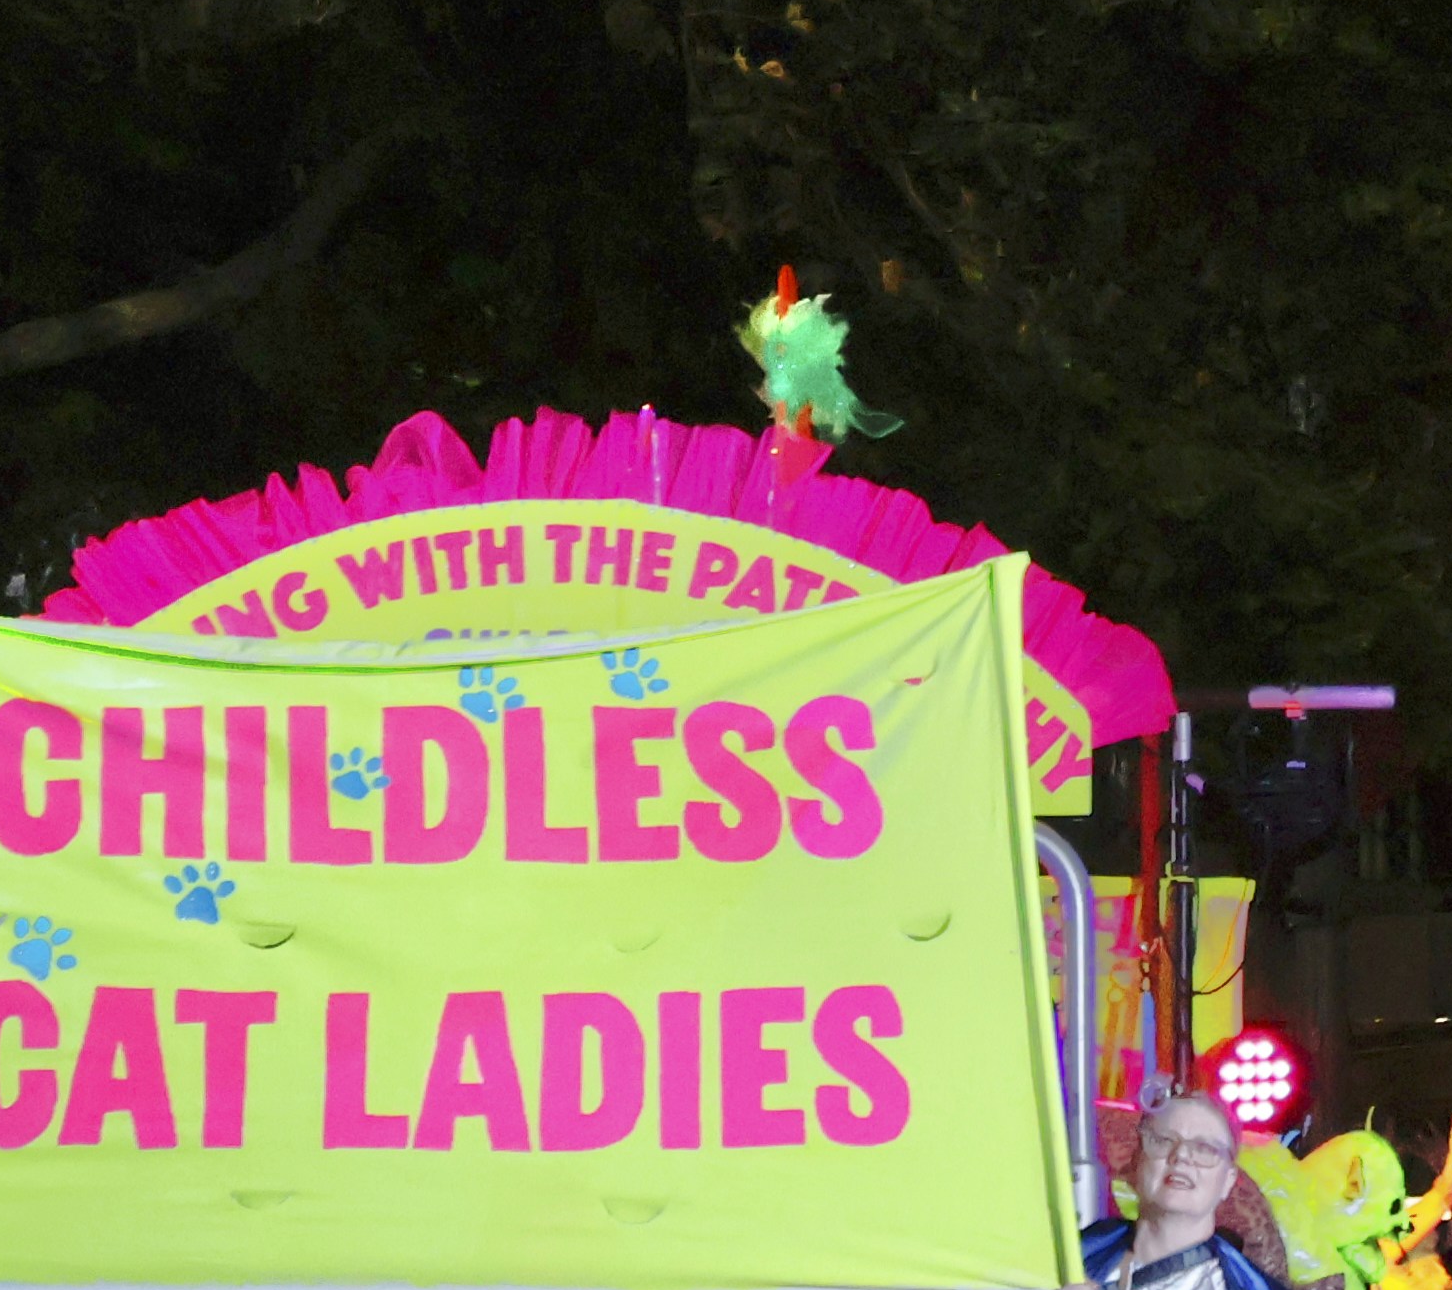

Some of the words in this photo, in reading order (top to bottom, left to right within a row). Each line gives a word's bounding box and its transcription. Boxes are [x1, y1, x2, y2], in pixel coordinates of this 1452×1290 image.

[334, 525, 525, 611] WITH
[543, 523, 675, 593] THE
[319, 982, 912, 1155] LADIES
